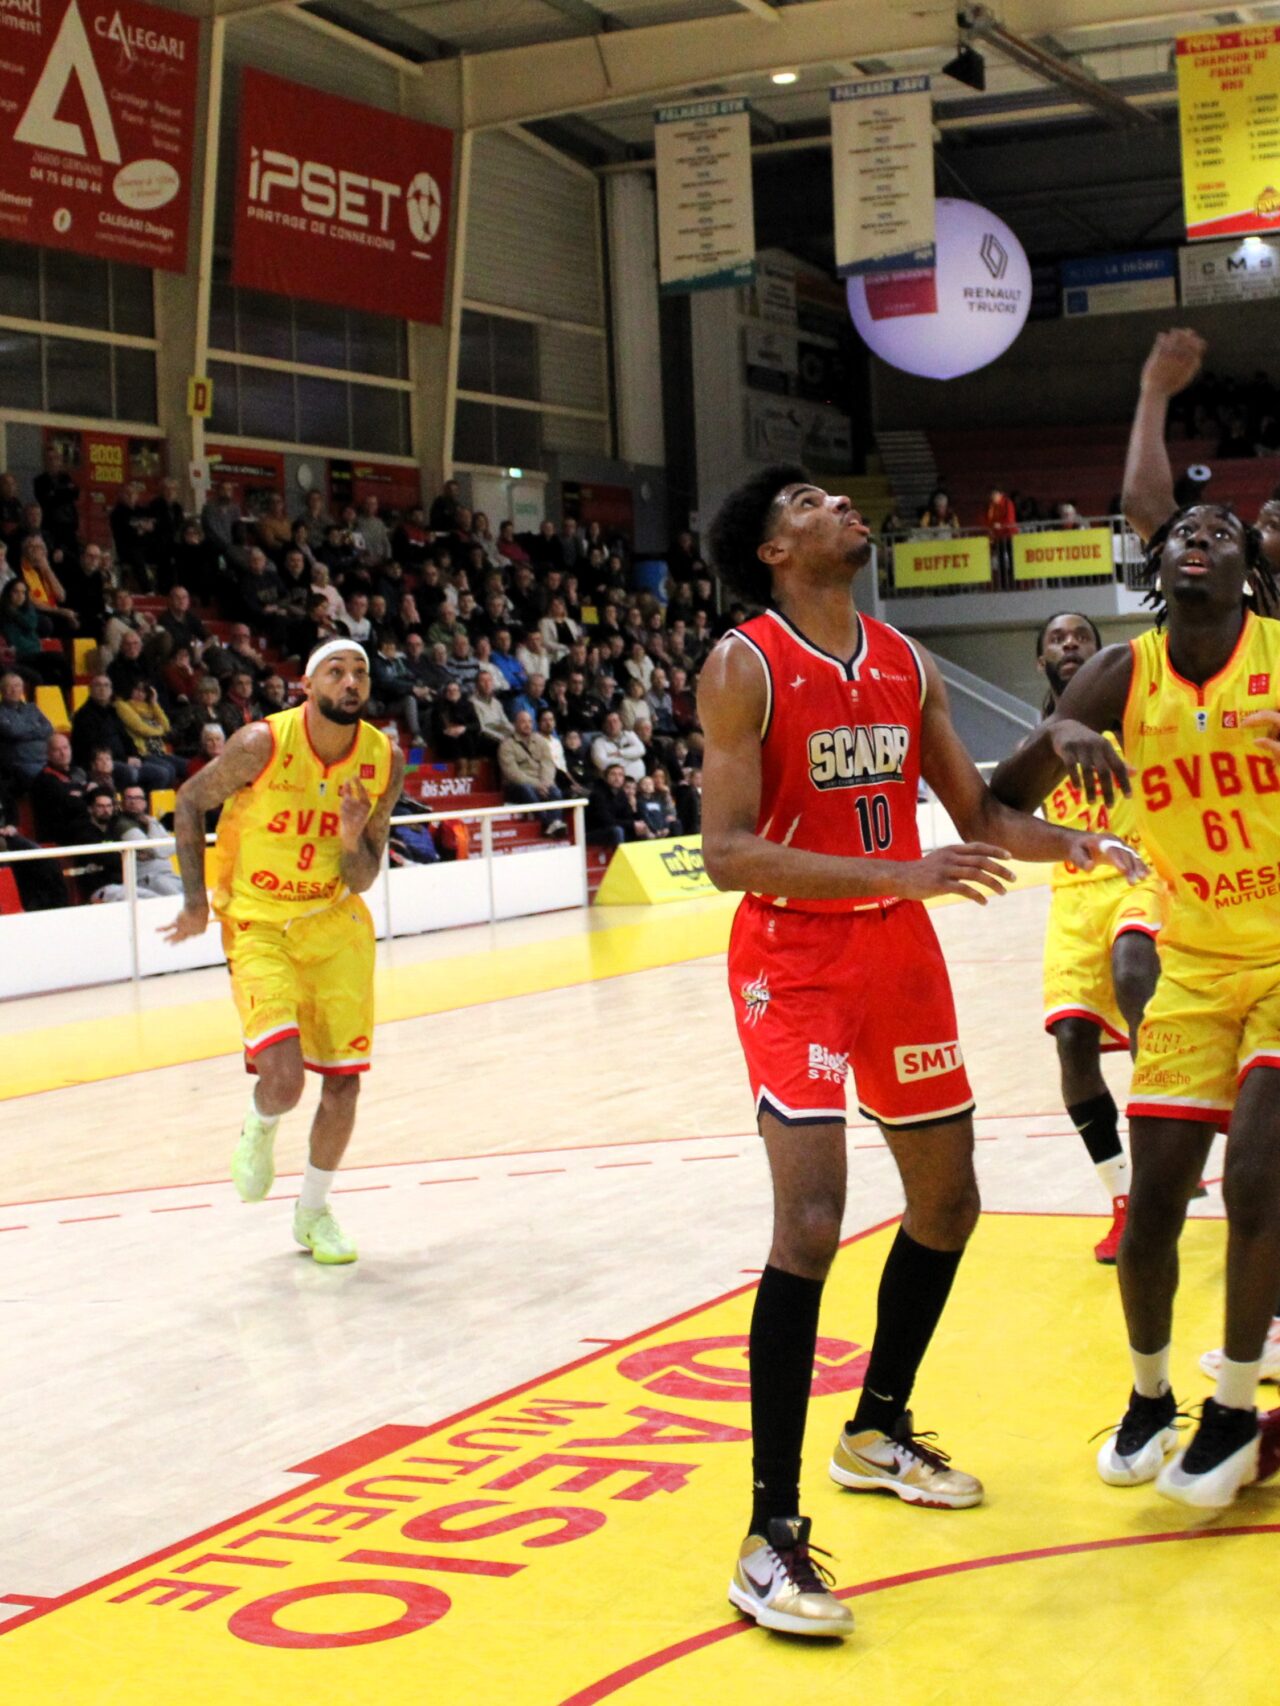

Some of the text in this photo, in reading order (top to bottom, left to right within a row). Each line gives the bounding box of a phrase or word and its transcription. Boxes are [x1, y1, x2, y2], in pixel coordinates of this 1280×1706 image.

[94, 9, 186, 61] CALEGARI
[247, 205, 396, 251] PARTAGE DE CONNEXIONS
[963, 287, 1022, 301] RENAULT
[967, 301, 1018, 315] TRUCKS
[913, 553, 970, 572] BUFFET
[1024, 545, 1102, 563] BOUTIQUE
[439, 777, 474, 797] SPORT
[1141, 752, 1280, 812] SVBD
[855, 794, 892, 853] 10
[1202, 809, 1252, 854] 61
[297, 843, 315, 871] 9
[902, 1044, 960, 1076] SMT
[108, 1397, 608, 1612] MUTUELLE
